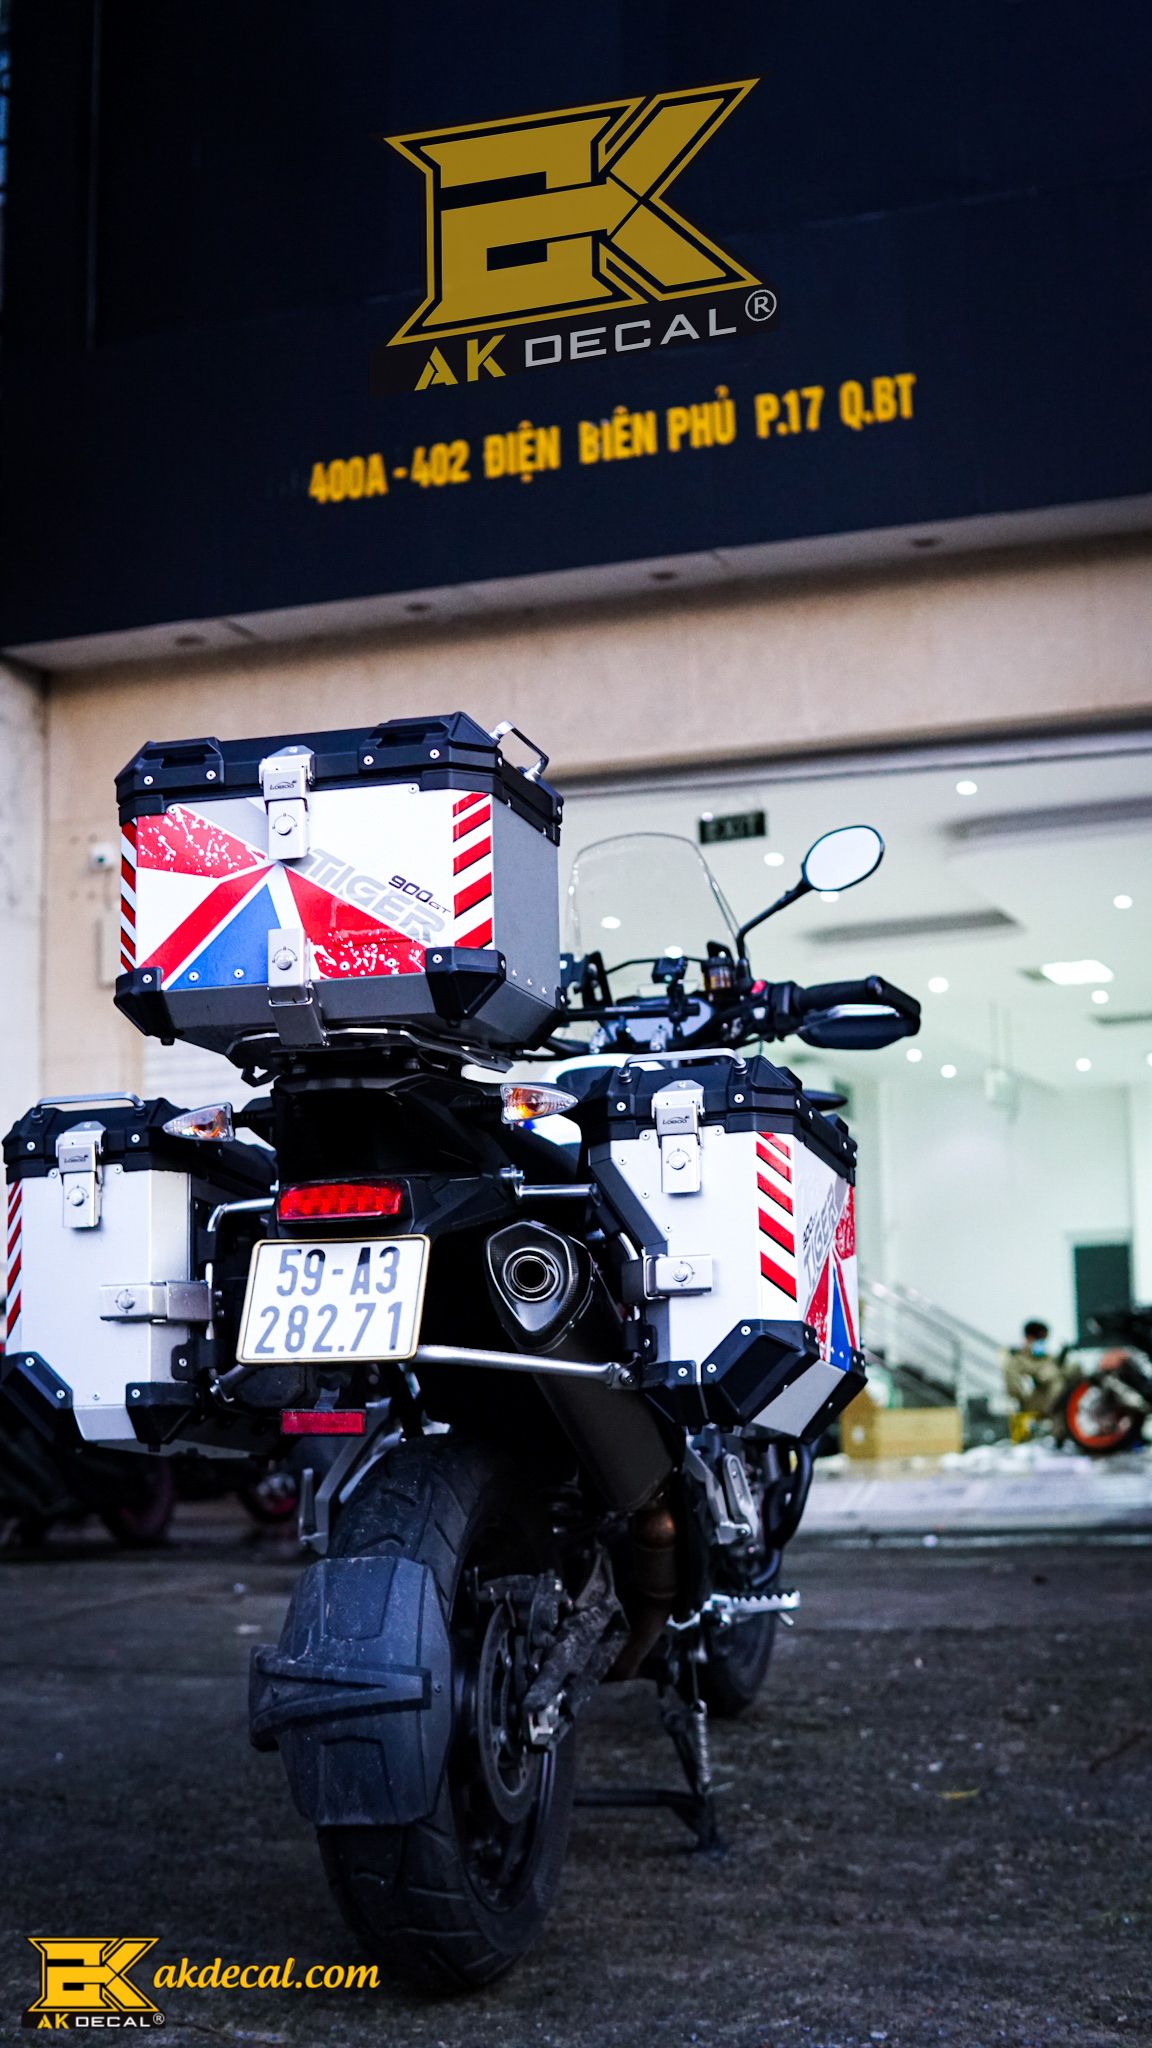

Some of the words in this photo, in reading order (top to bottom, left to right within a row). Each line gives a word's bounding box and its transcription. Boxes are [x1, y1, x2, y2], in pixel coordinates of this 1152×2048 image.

[755, 385, 824, 439] P.17
[839, 373, 916, 430] Q.BT
[306, 848, 445, 944] TIGER
[276, 1246, 401, 1296] 59-A3
[254, 1301, 403, 1354] 282.71
